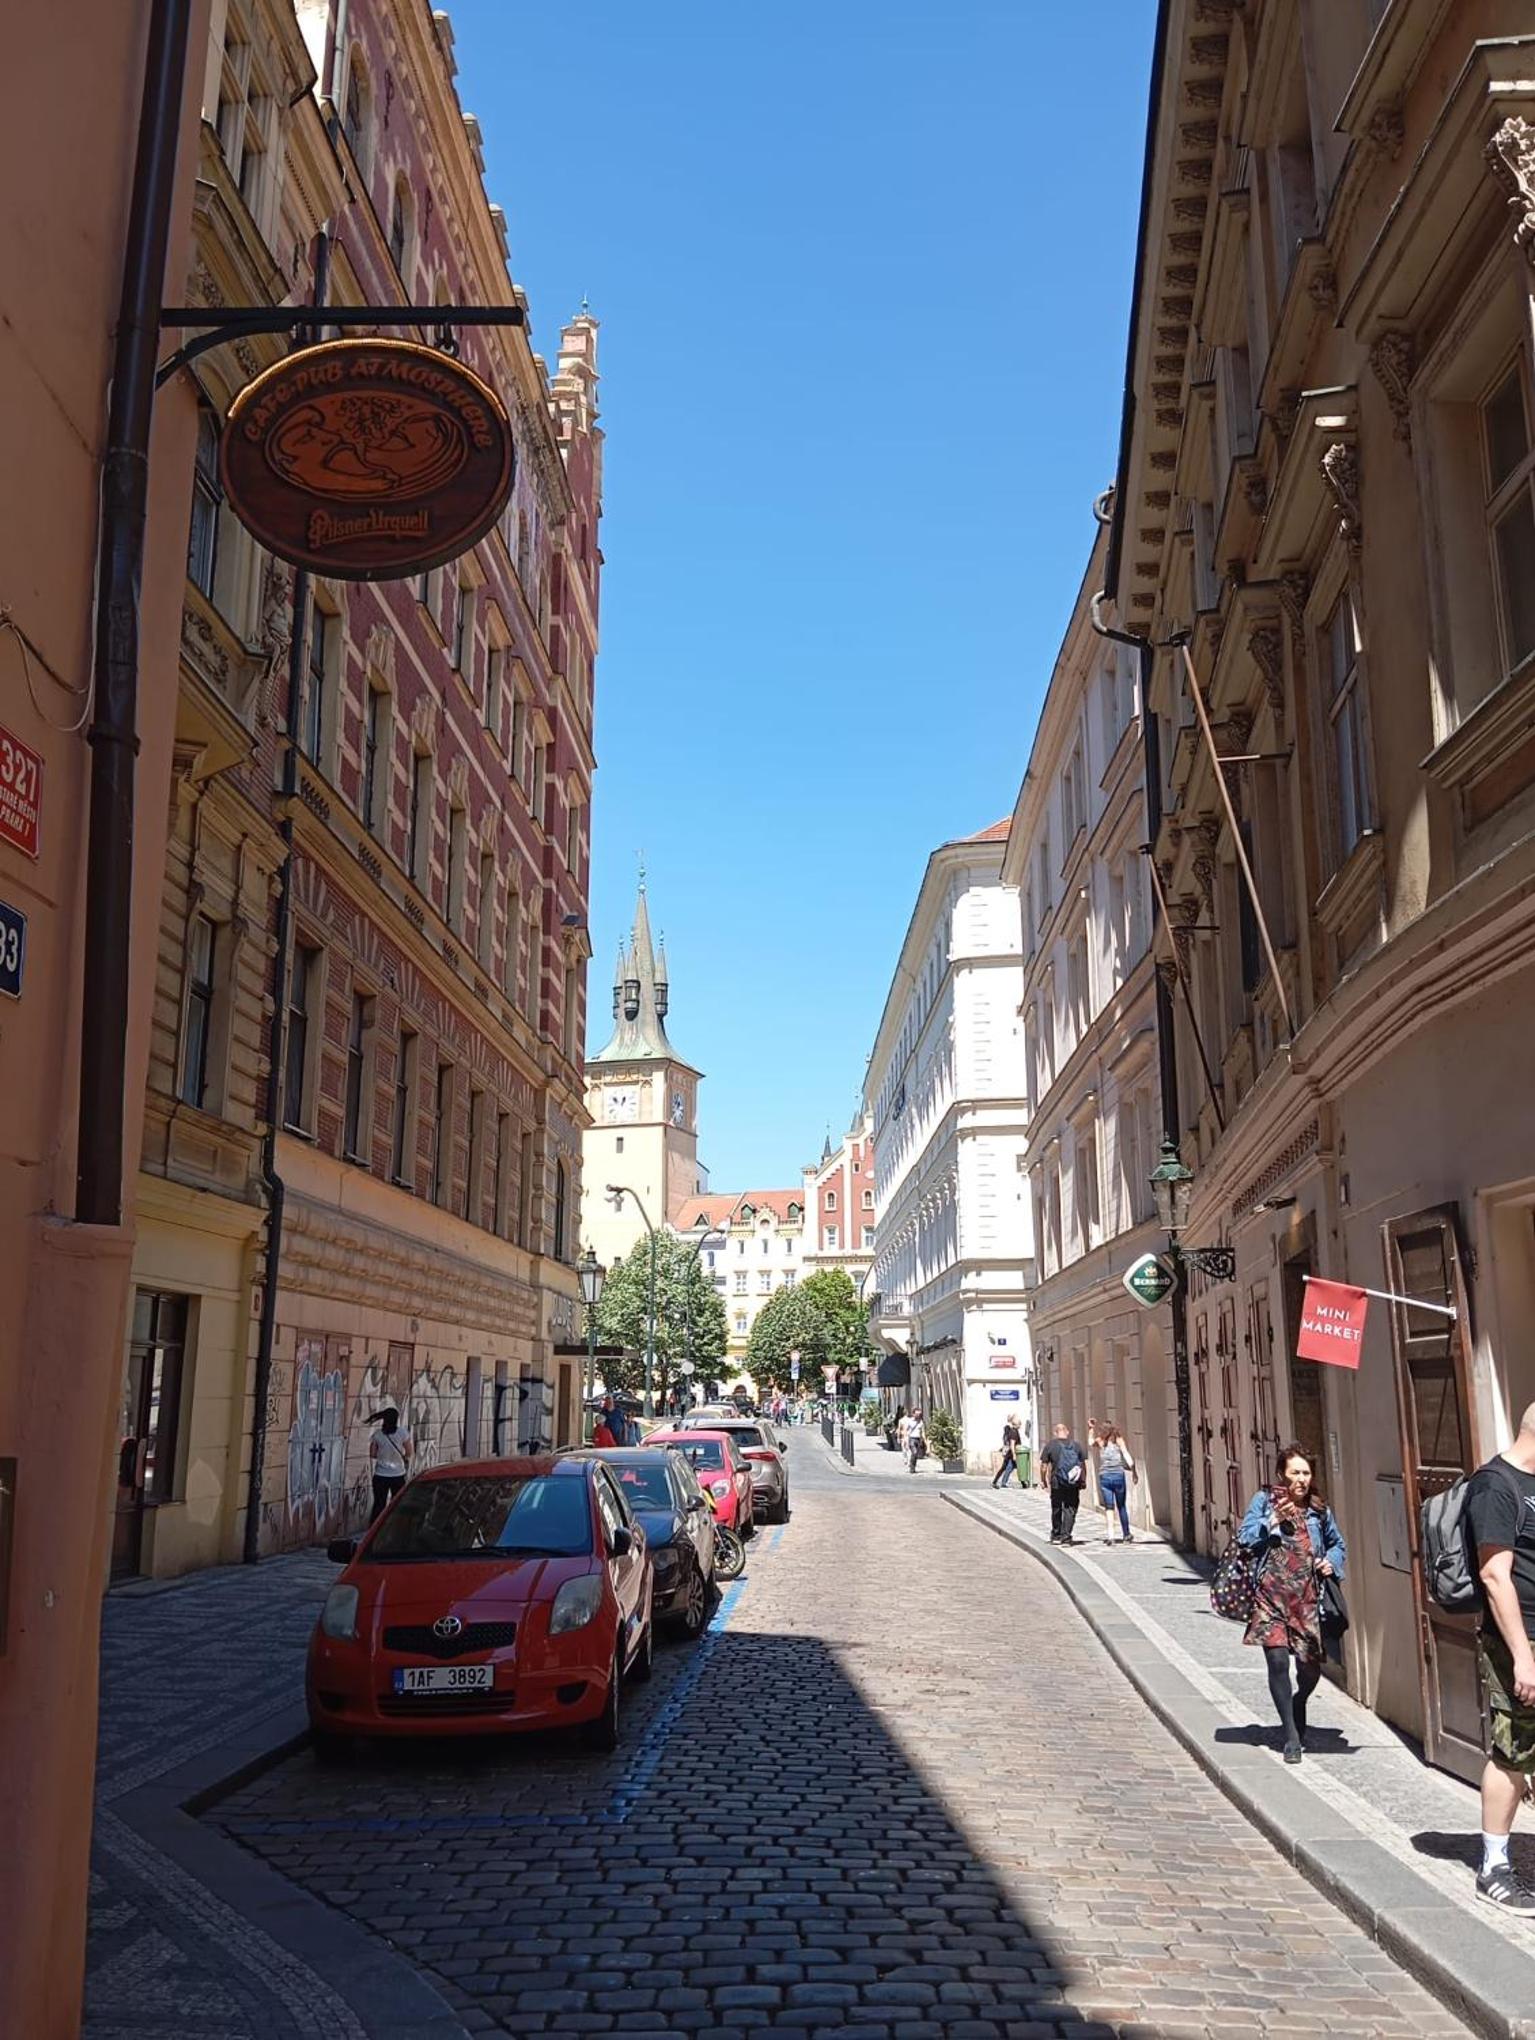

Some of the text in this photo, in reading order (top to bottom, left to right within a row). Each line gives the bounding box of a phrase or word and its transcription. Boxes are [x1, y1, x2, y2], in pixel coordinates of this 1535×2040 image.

[309, 507, 429, 549] Pilsner Urquell
[2, 740, 36, 802] 327
[1316, 1305, 1350, 1321] MINI
[1302, 1319, 1361, 1341] MARKET
[407, 1668, 487, 1688] 1AF 3892
